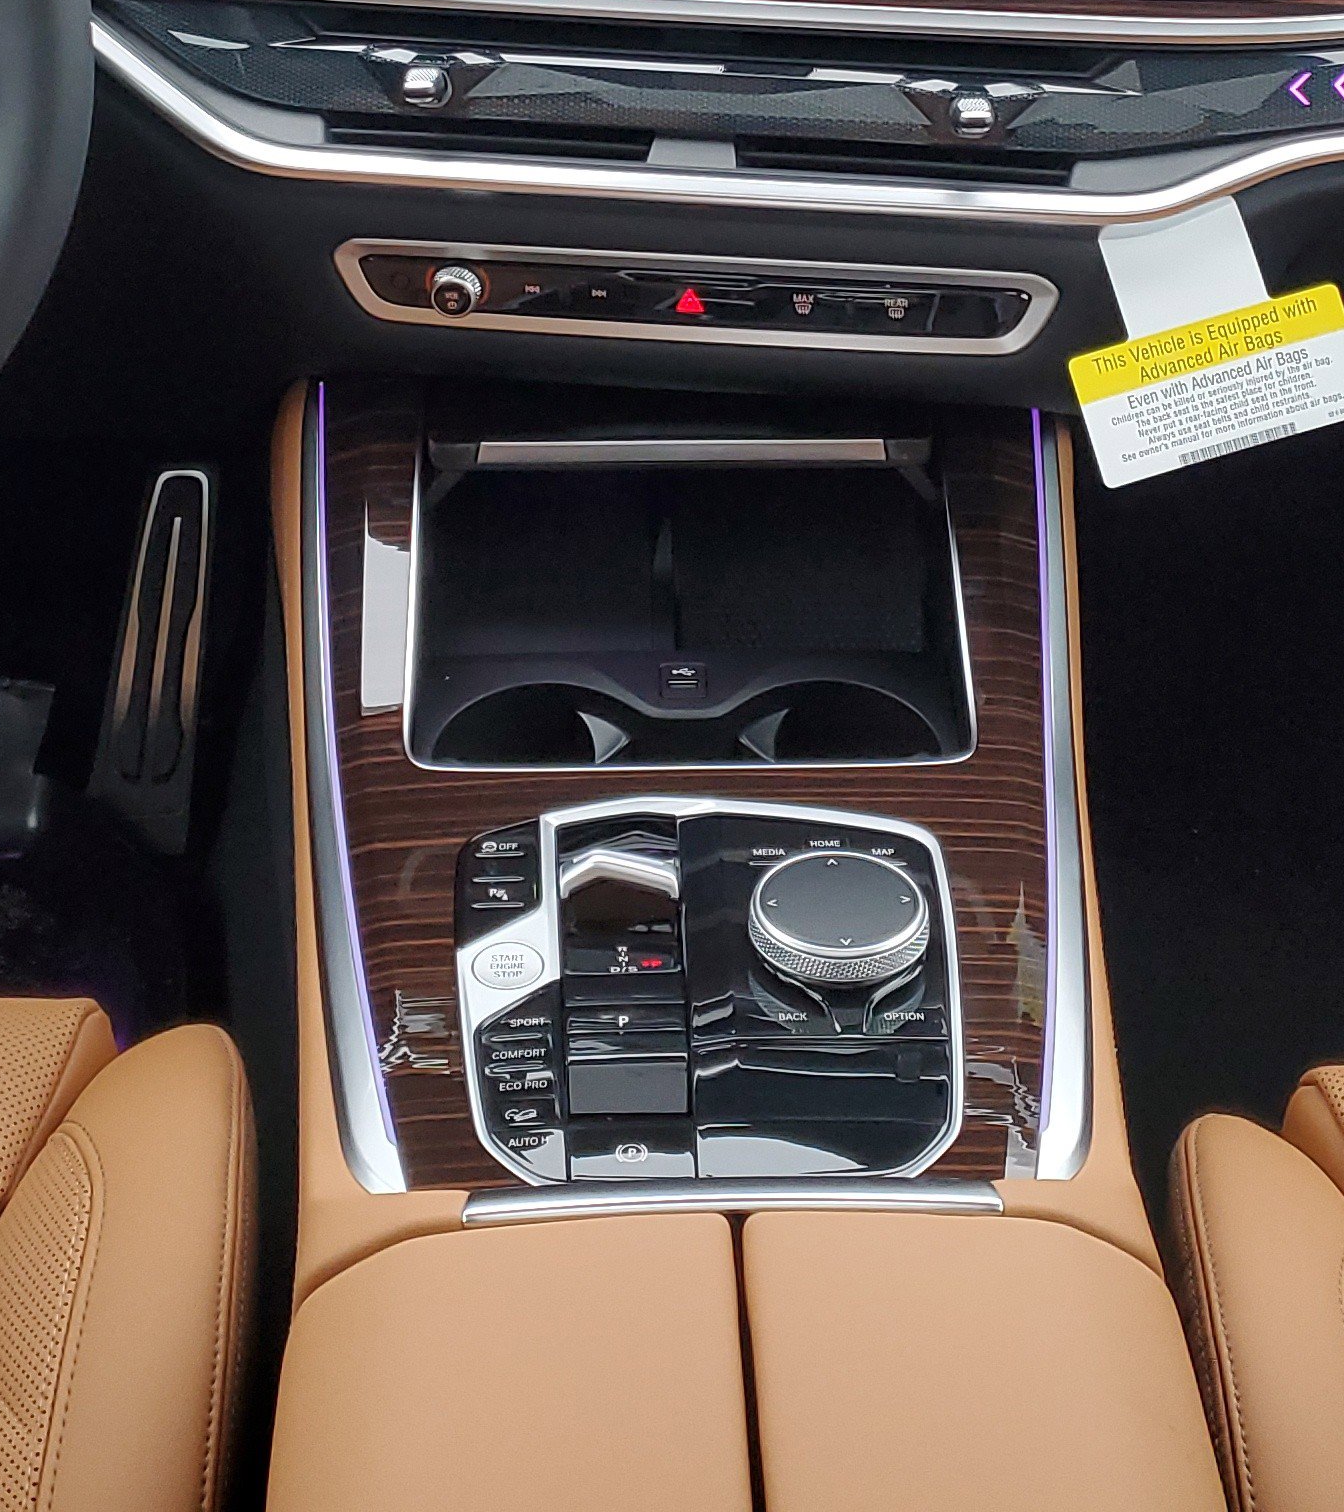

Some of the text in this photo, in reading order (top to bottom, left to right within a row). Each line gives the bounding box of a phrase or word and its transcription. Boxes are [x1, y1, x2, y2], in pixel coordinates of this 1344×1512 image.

[793, 294, 814, 304] MAX
[884, 298, 908, 308] REAR
[1092, 297, 1317, 375] This Vehicle is Equipped with
[1140, 330, 1283, 383] Advanced Air Bags
[1127, 348, 1309, 409] Even with Advanced Air Bags
[1111, 410, 1144, 426] Children
[1147, 405, 1161, 415] can
[1163, 401, 1172, 411] be
[1198, 392, 1206, 400] or
[1208, 379, 1243, 397] seriously
[1246, 370, 1274, 387] injured
[1276, 368, 1285, 380] by
[1287, 364, 1300, 375] the
[1303, 361, 1313, 371] air
[1136, 418, 1151, 429] The
[1153, 412, 1171, 425] back
[1174, 407, 1189, 418] seat
[1201, 398, 1213, 408] the
[1216, 390, 1240, 405] safest
[1242, 385, 1263, 399] place
[1264, 379, 1276, 391] for
[1138, 424, 1160, 438] Never
[1164, 419, 1176, 432] put
[1185, 406, 1227, 424] rear-facing
[1229, 399, 1249, 413] child
[1251, 392, 1268, 405] seat
[1280, 385, 1292, 396] the
[1148, 429, 1176, 445] Always
[1178, 426, 1192, 436] use
[1194, 420, 1210, 432] seat
[1213, 413, 1232, 427] belts
[1234, 408, 1248, 420] and
[1250, 402, 1270, 416] child
[1121, 452, 1137, 463] See
[1171, 432, 1200, 448] manual
[1201, 428, 1213, 439] for
[1215, 423, 1236, 436] more
[1237, 410, 1284, 429] information
[1285, 401, 1308, 416] about
[1310, 398, 1320, 409] air
[498, 842, 518, 851] OFF
[809, 840, 841, 848] HOME
[752, 848, 786, 856] MEDIA
[871, 848, 895, 856] MAP
[491, 954, 524, 962] START
[493, 970, 523, 978] STOP
[618, 1015, 629, 1027] P
[778, 1012, 808, 1021] BACK
[883, 1012, 925, 1022] OPTION
[509, 1017, 545, 1028] SPORT
[492, 1048, 547, 1060] COMFORT
[499, 1080, 548, 1092] ECO PRO
[508, 1137, 538, 1148] AUTO
